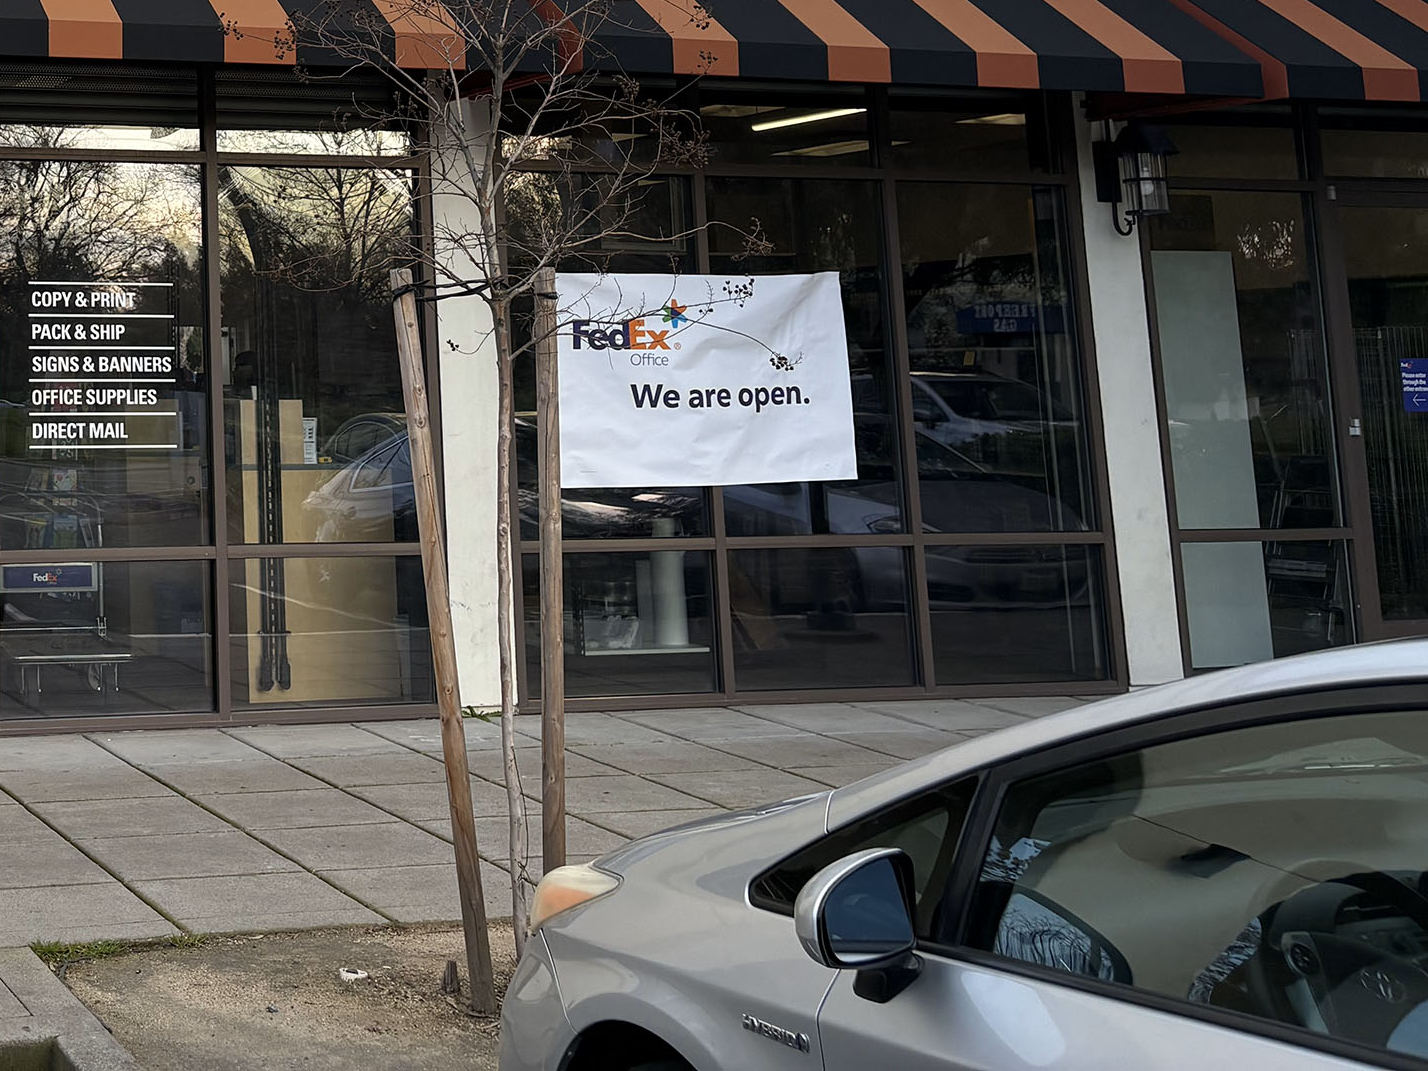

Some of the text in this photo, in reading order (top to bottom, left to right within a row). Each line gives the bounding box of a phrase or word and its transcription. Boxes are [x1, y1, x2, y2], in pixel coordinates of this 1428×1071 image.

[31, 291, 136, 308] COPY & PRINT
[31, 324, 126, 340] PACK & SHIP
[572, 319, 671, 350] FedEx
[32, 356, 172, 372] SIGNS & BANNERS
[630, 353, 669, 366] Office
[32, 389, 157, 405] OFFICE SUPPLIES
[630, 384, 810, 412] We are open.
[32, 423, 128, 439] DIRECT MAIL
[33, 572, 58, 582] FedEx
